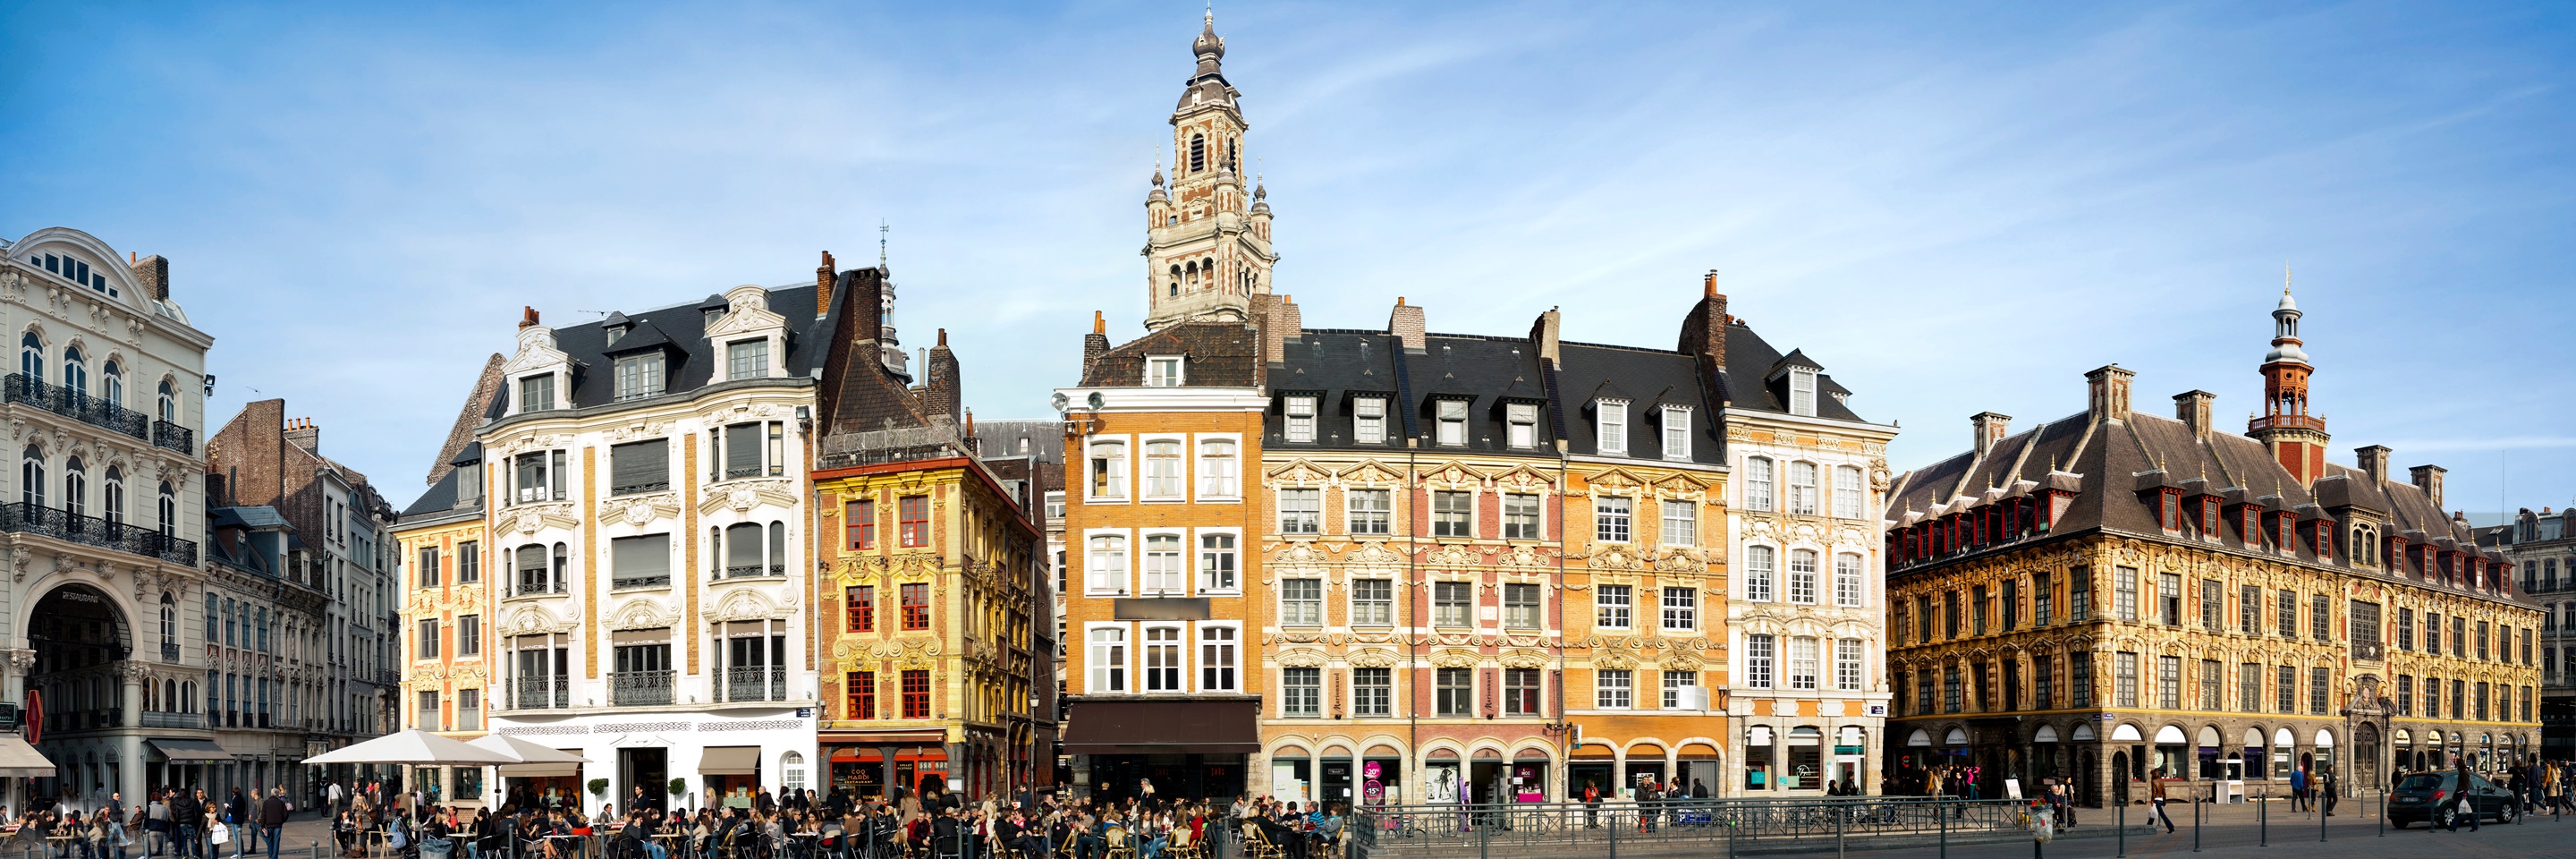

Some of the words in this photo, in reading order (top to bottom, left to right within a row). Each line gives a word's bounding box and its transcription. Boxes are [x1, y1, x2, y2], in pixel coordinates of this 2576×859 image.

[63, 591, 98, 603] RESTAURANT
[1333, 673, 1343, 714] Marionnaud
[1485, 672, 1494, 712] Marionnaud
